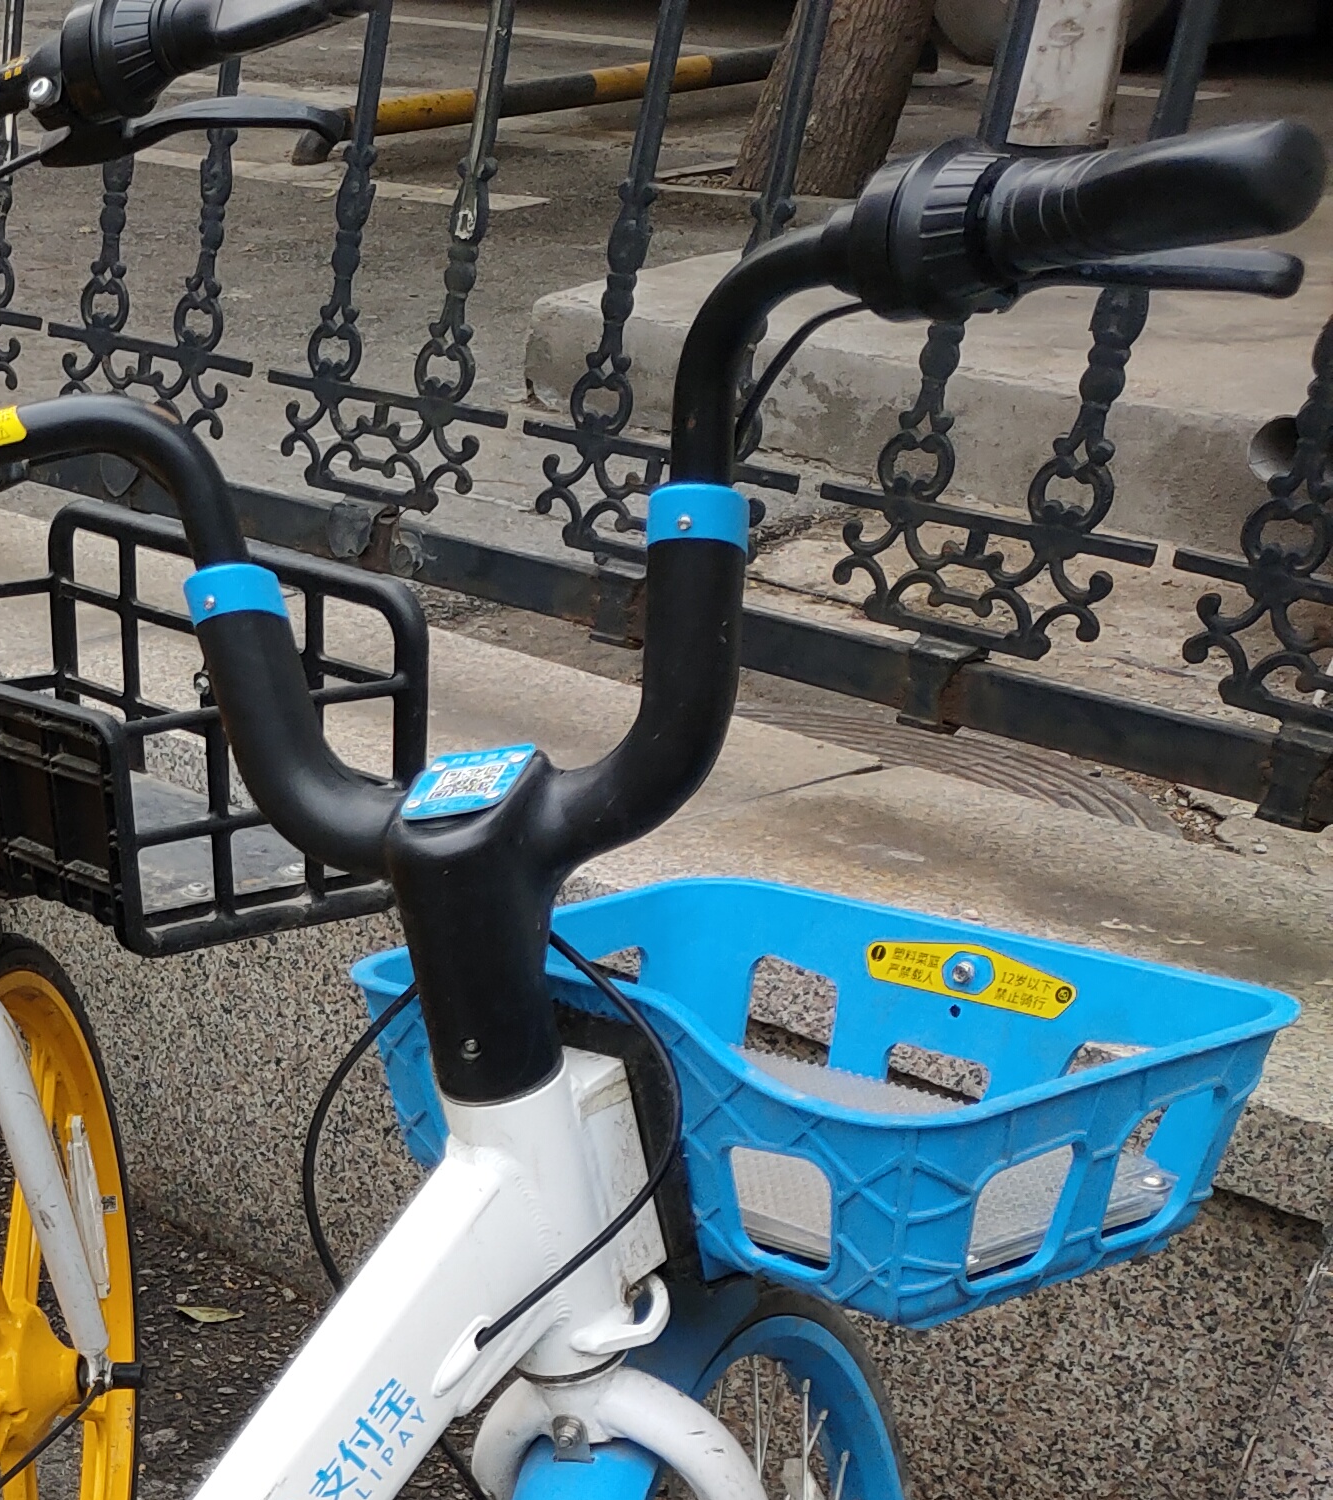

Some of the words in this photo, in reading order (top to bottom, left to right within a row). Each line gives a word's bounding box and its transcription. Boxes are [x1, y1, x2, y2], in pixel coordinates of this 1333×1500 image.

[886, 963, 934, 986] 严禁载人
[1000, 971, 1055, 994] 12岁以下
[994, 988, 1048, 1010] 禁止骑行
